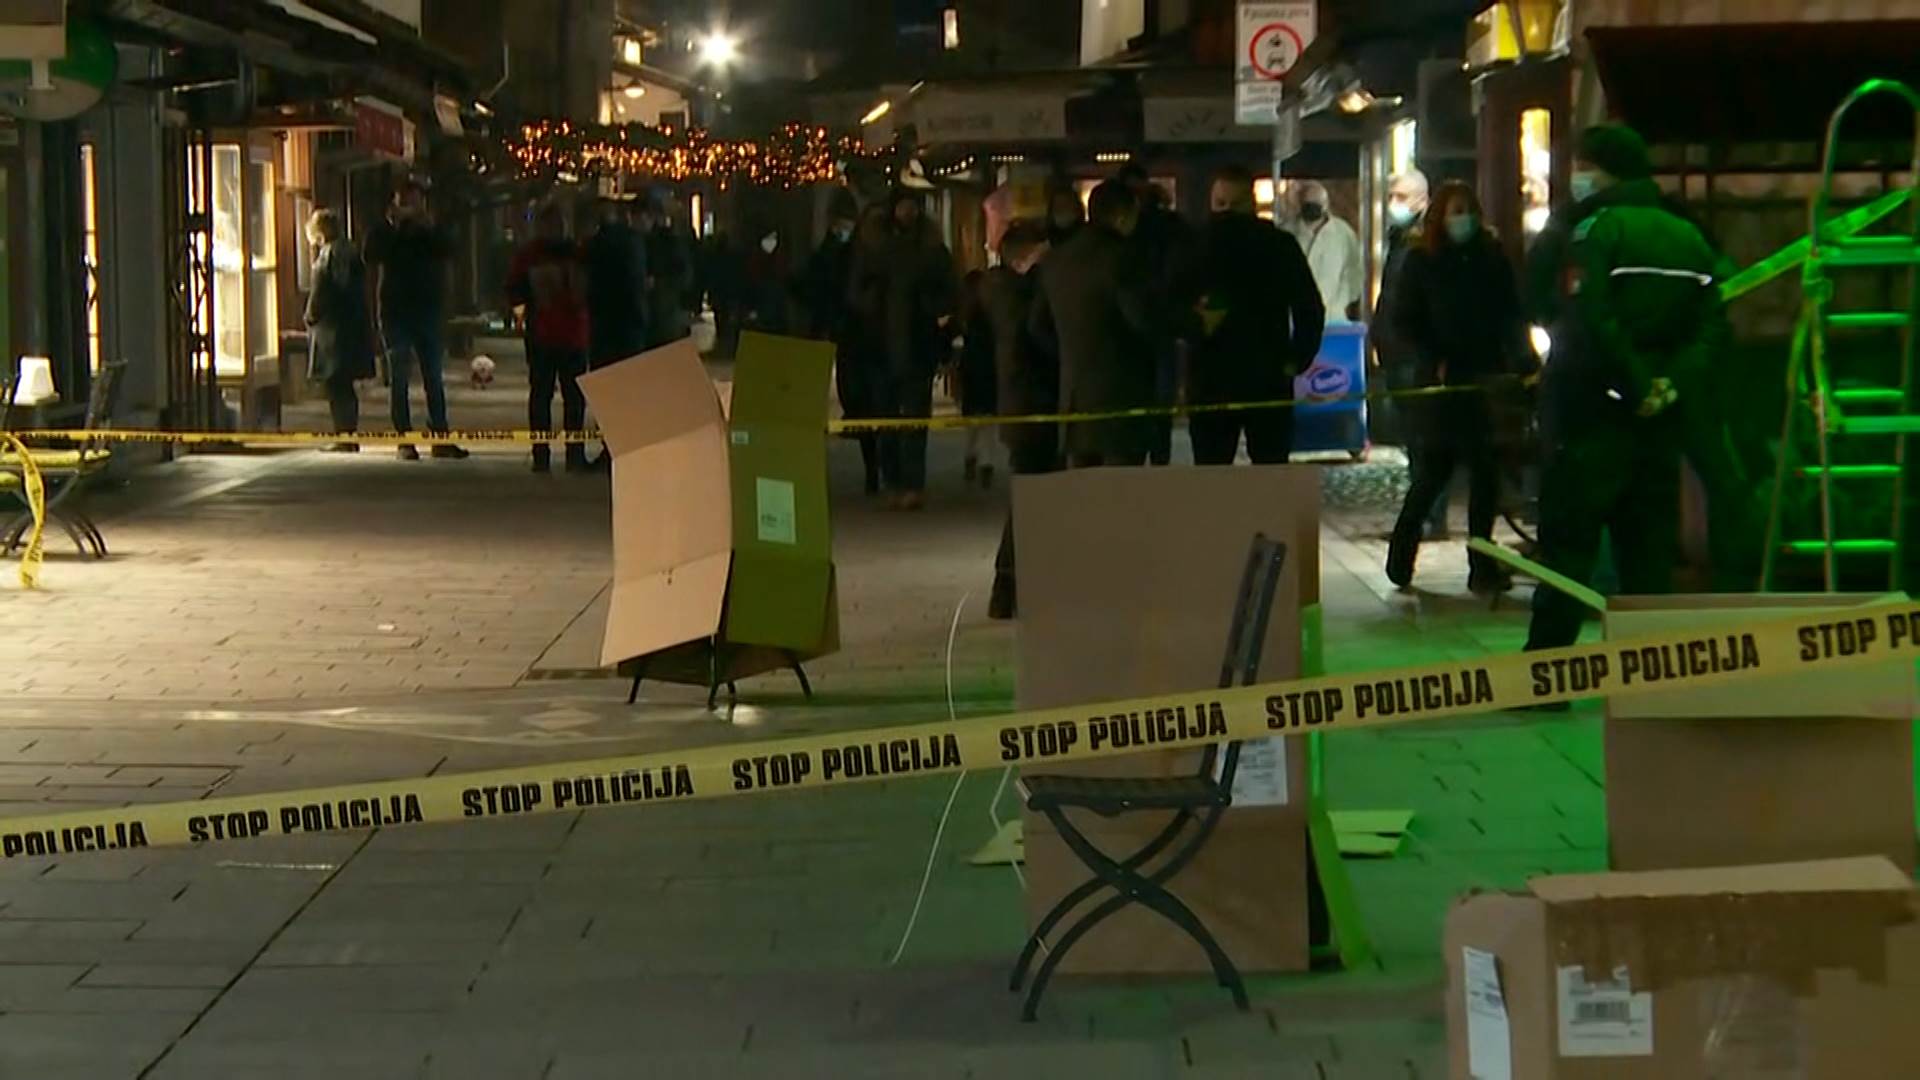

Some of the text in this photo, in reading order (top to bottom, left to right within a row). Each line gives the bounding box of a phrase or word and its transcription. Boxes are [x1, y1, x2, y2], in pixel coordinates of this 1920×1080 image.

[3, 821, 149, 859] POLICIJA
[188, 811, 270, 843] STOP
[280, 794, 424, 834] POLICIJA
[462, 783, 541, 818] STOP
[553, 764, 694, 810] POLICIJA
[732, 752, 811, 791] STOP
[822, 733, 962, 781] POLICIJA
[1000, 721, 1078, 762] STOP
[1089, 701, 1228, 751] POLICIJA
[1266, 688, 1344, 729] STOP
[1355, 668, 1495, 719] POLICIJA
[1531, 653, 1609, 697] STOP
[1620, 633, 1761, 685] POLICIJA
[1797, 617, 1877, 662] STOP
